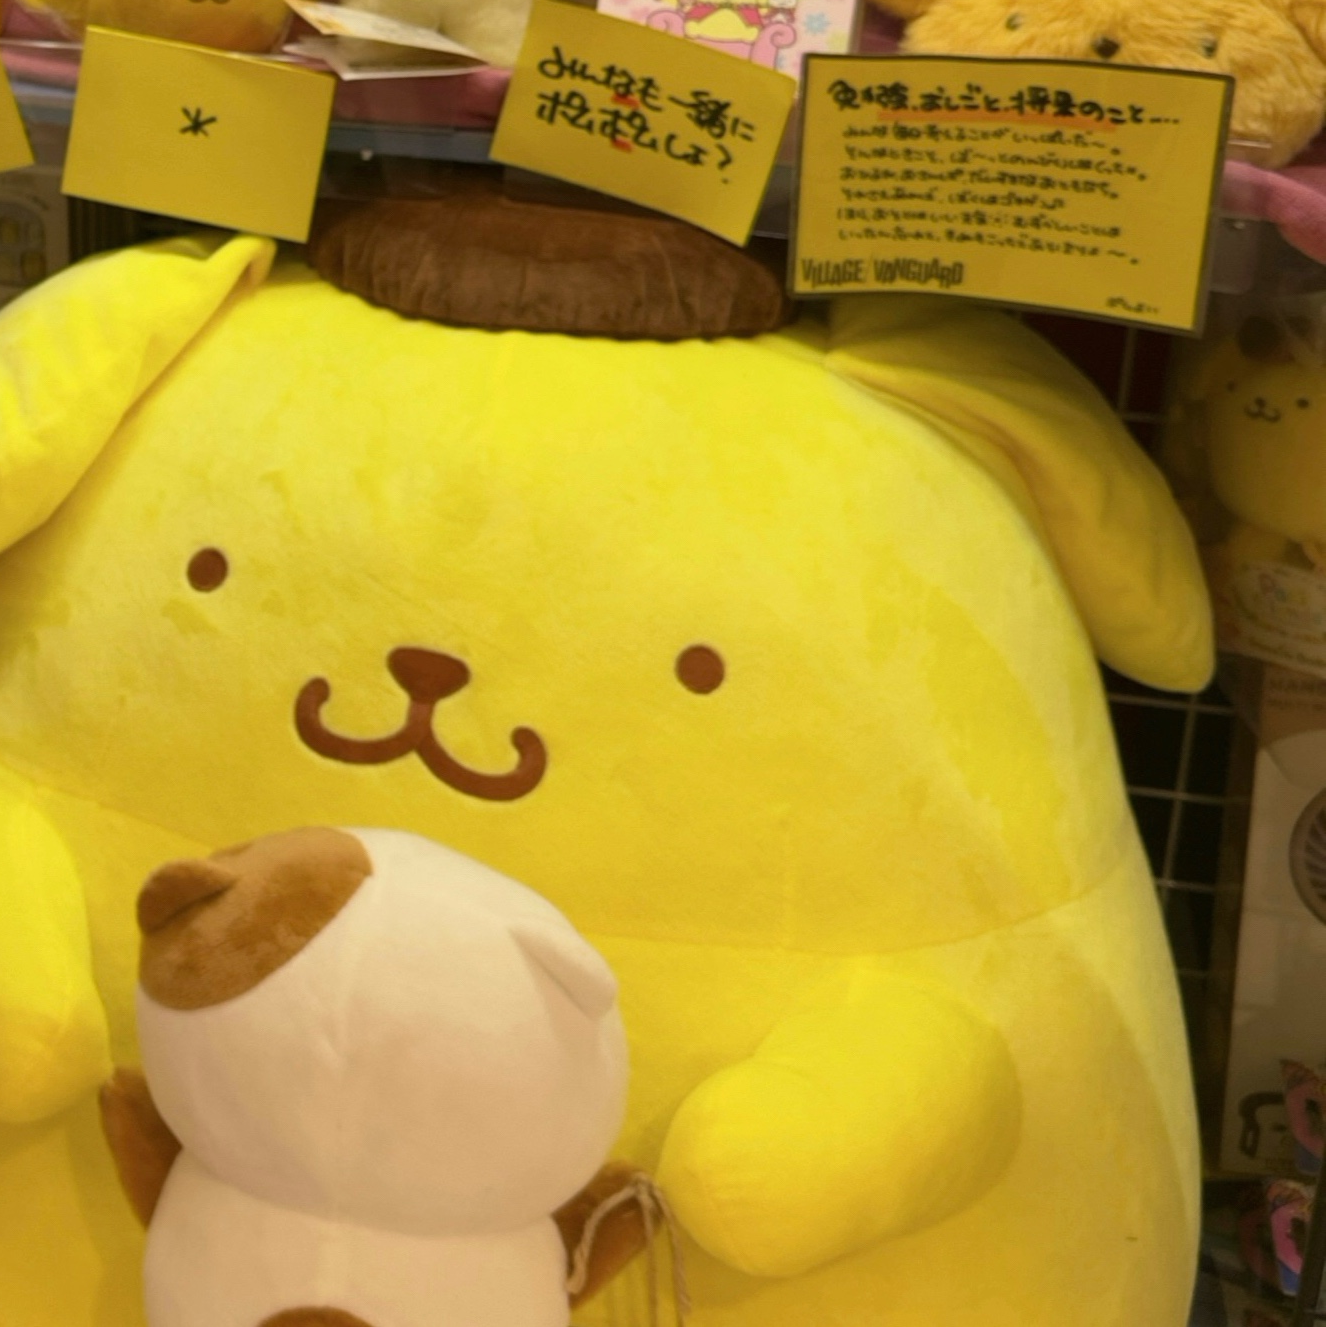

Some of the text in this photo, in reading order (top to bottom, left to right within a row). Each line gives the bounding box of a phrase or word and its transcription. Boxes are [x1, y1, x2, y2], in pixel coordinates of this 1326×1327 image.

[537, 46, 755, 145] みんなも一緒に
[800, 257, 965, 289] VILLAGE VANGUARD
